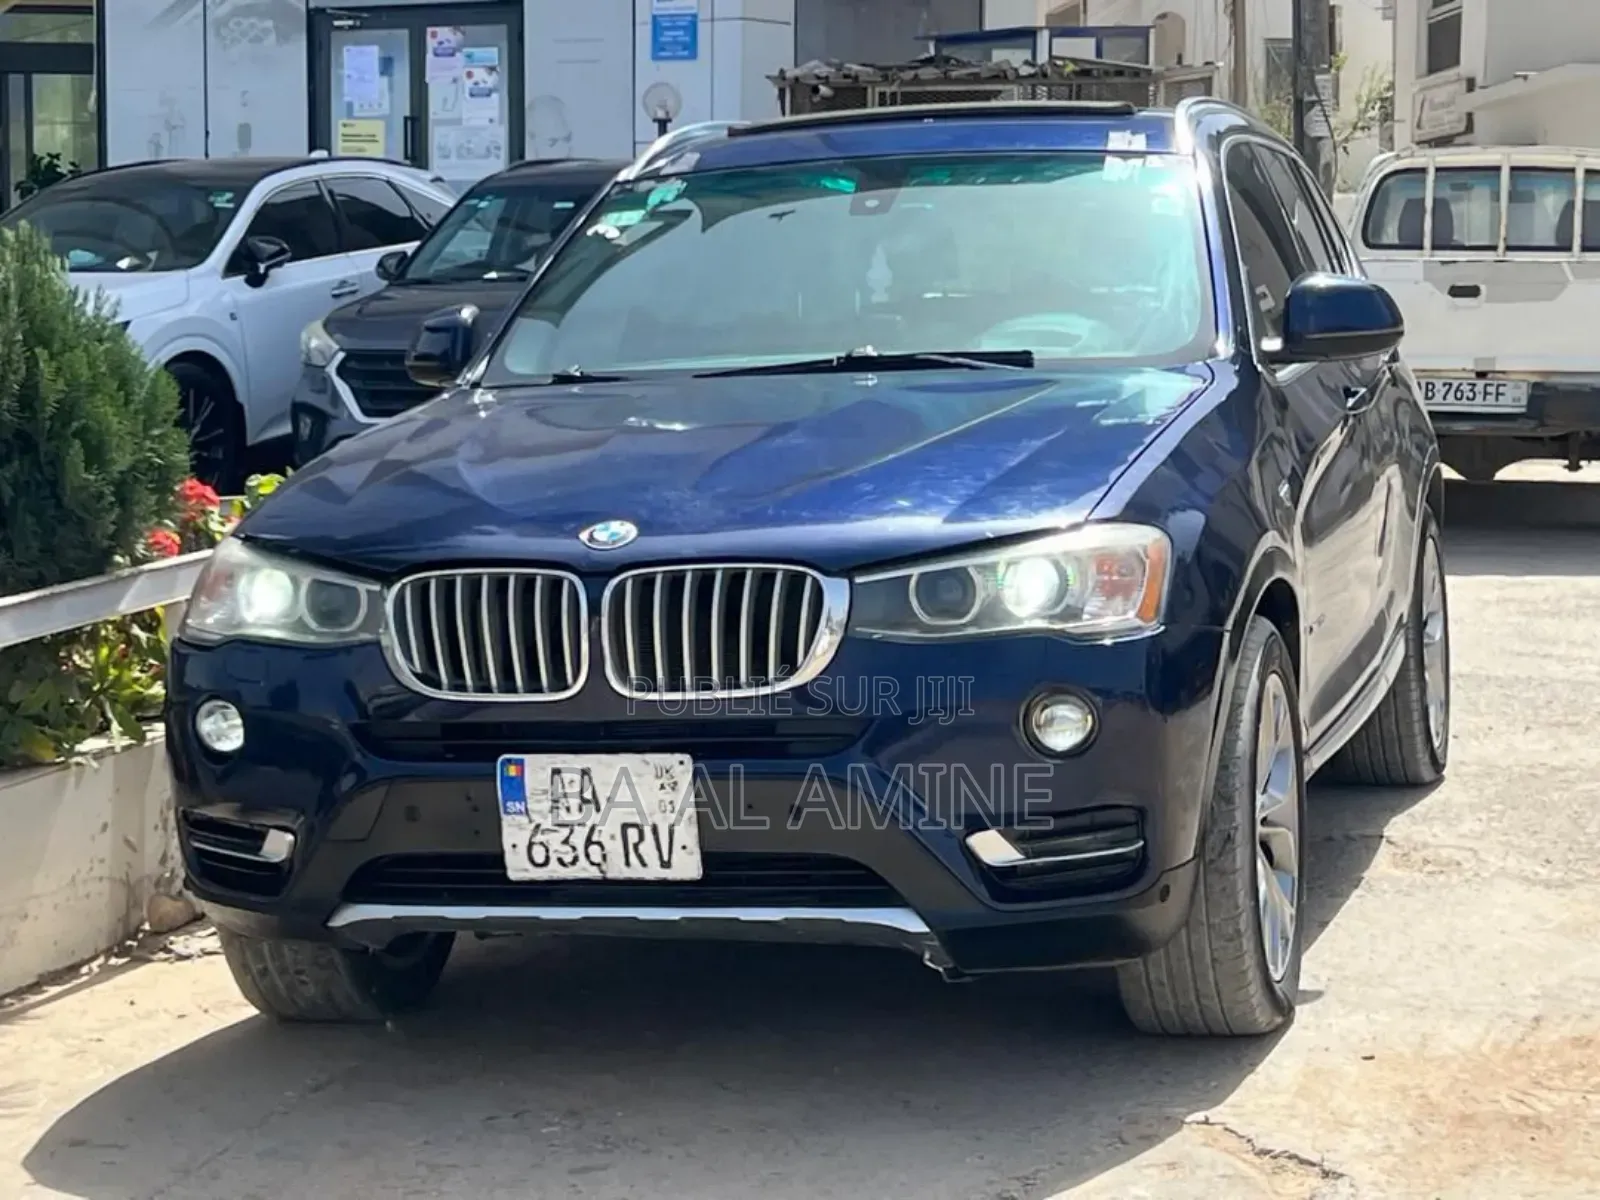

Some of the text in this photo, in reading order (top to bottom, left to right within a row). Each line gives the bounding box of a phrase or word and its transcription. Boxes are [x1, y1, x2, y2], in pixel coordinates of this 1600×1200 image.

[1442, 382, 1477, 401] 763
[1482, 383, 1507, 402] FF
[505, 801, 526, 814] SN
[527, 822, 676, 869] 636 RV
